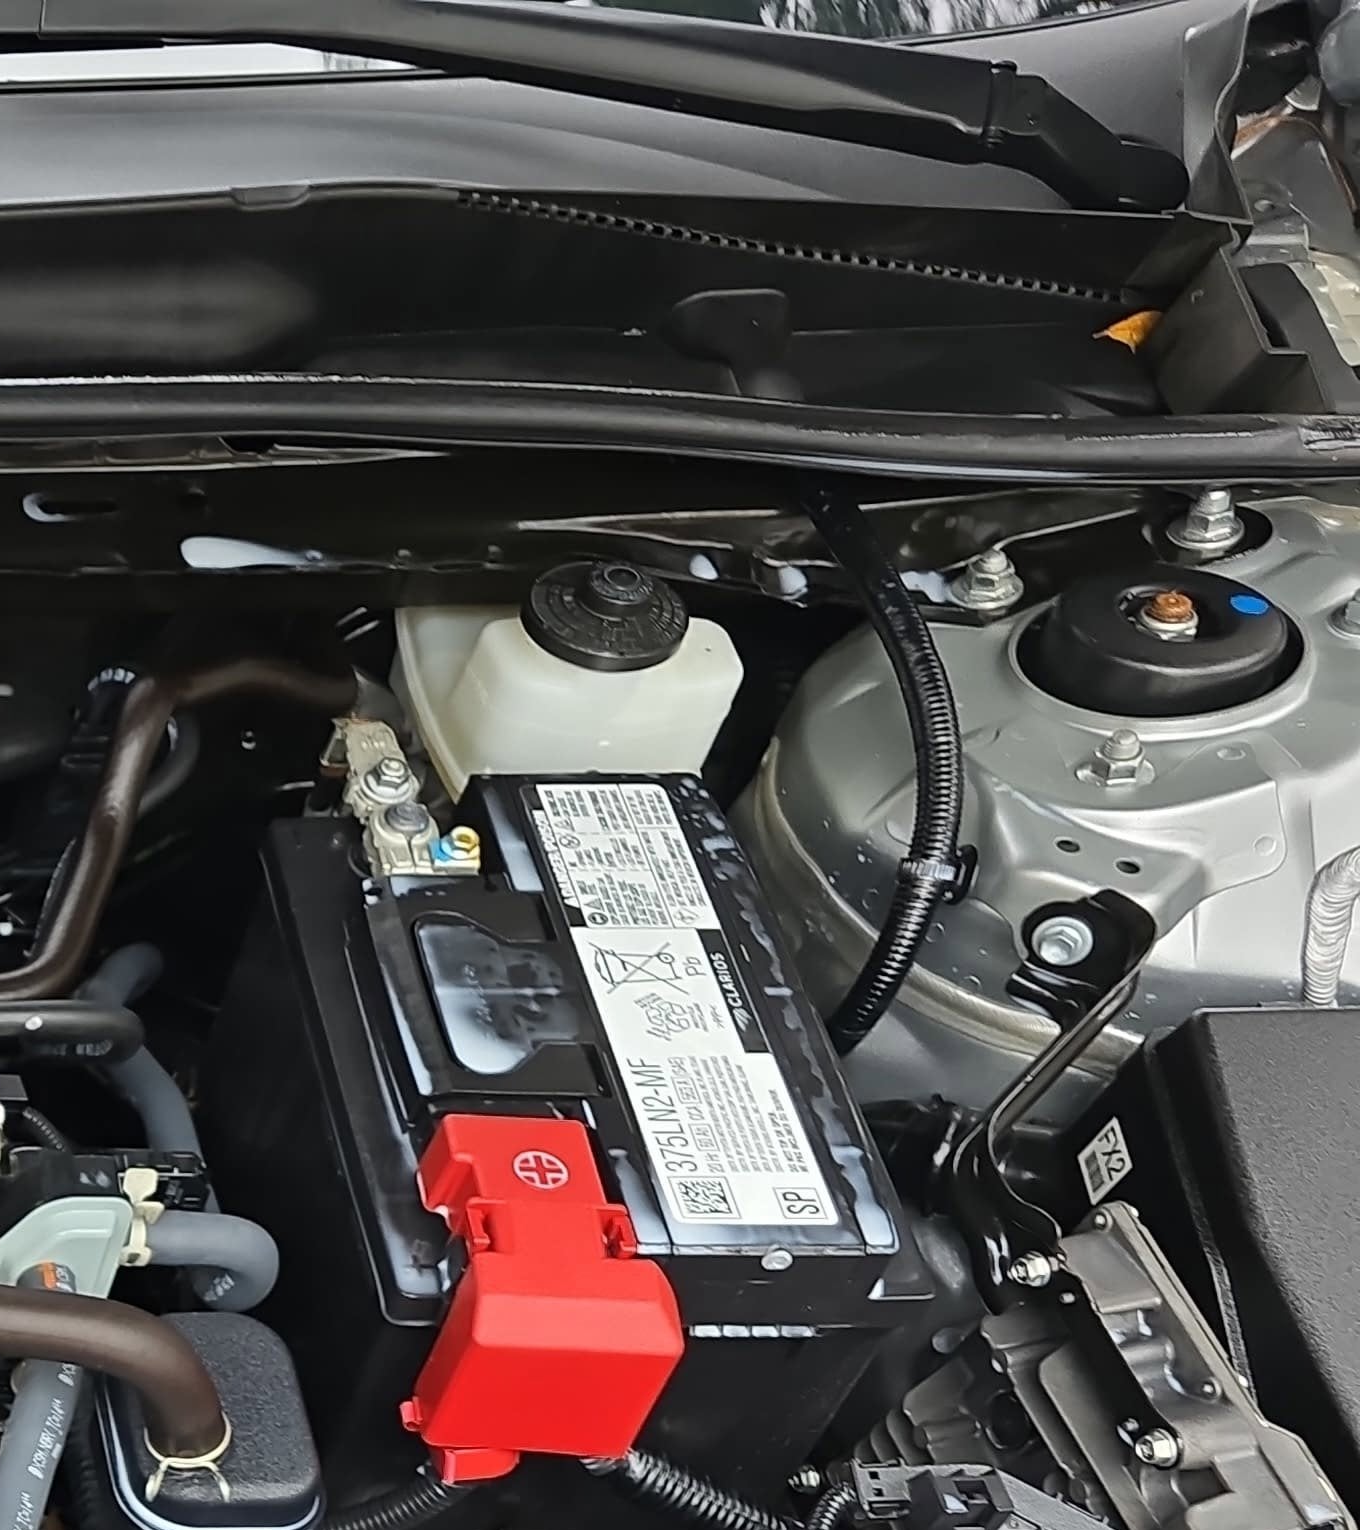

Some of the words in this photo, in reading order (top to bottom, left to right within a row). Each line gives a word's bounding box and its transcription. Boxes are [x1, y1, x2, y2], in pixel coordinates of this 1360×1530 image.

[710, 952, 743, 1008] CLARIOS
[626, 1057, 698, 1173] 375LN2-MF
[1097, 1125, 1126, 1182] FX2
[781, 1191, 821, 1215] SP
